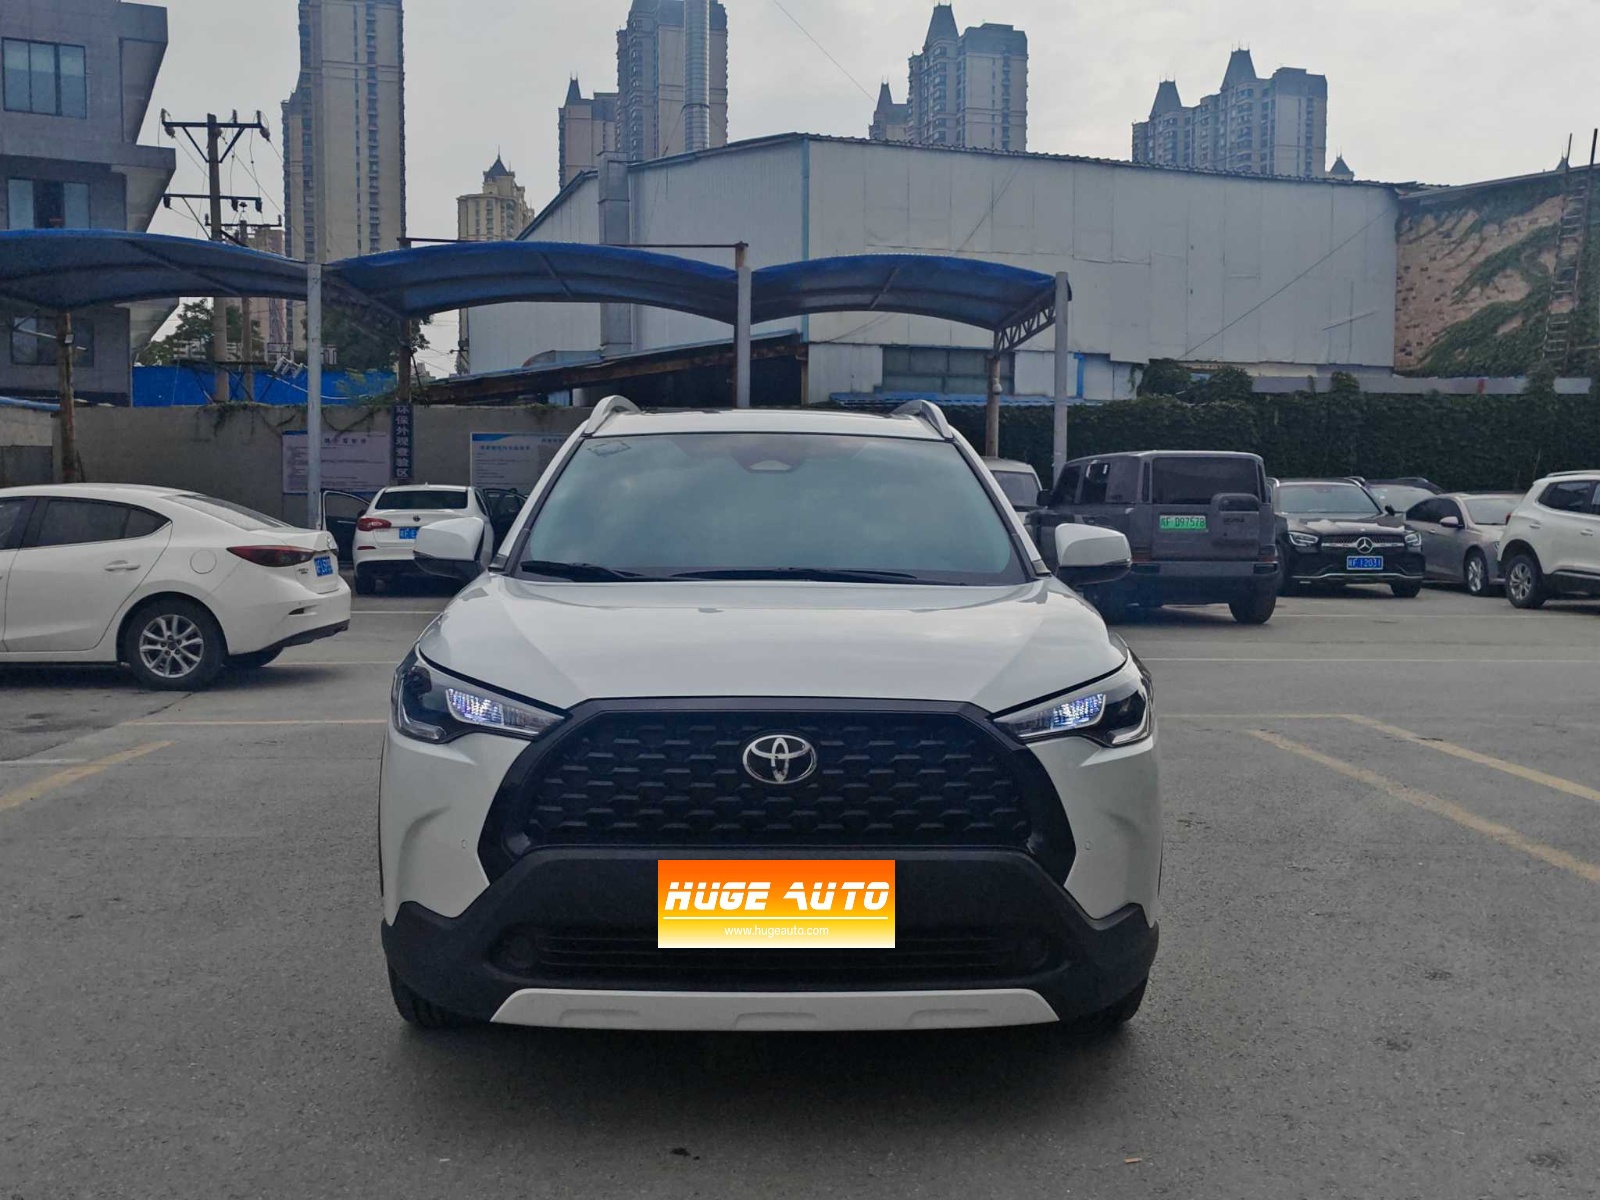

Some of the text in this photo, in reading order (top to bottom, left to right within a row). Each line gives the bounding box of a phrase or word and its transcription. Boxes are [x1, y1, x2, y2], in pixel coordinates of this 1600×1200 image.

[395, 404, 410, 478] 环保外观查验区
